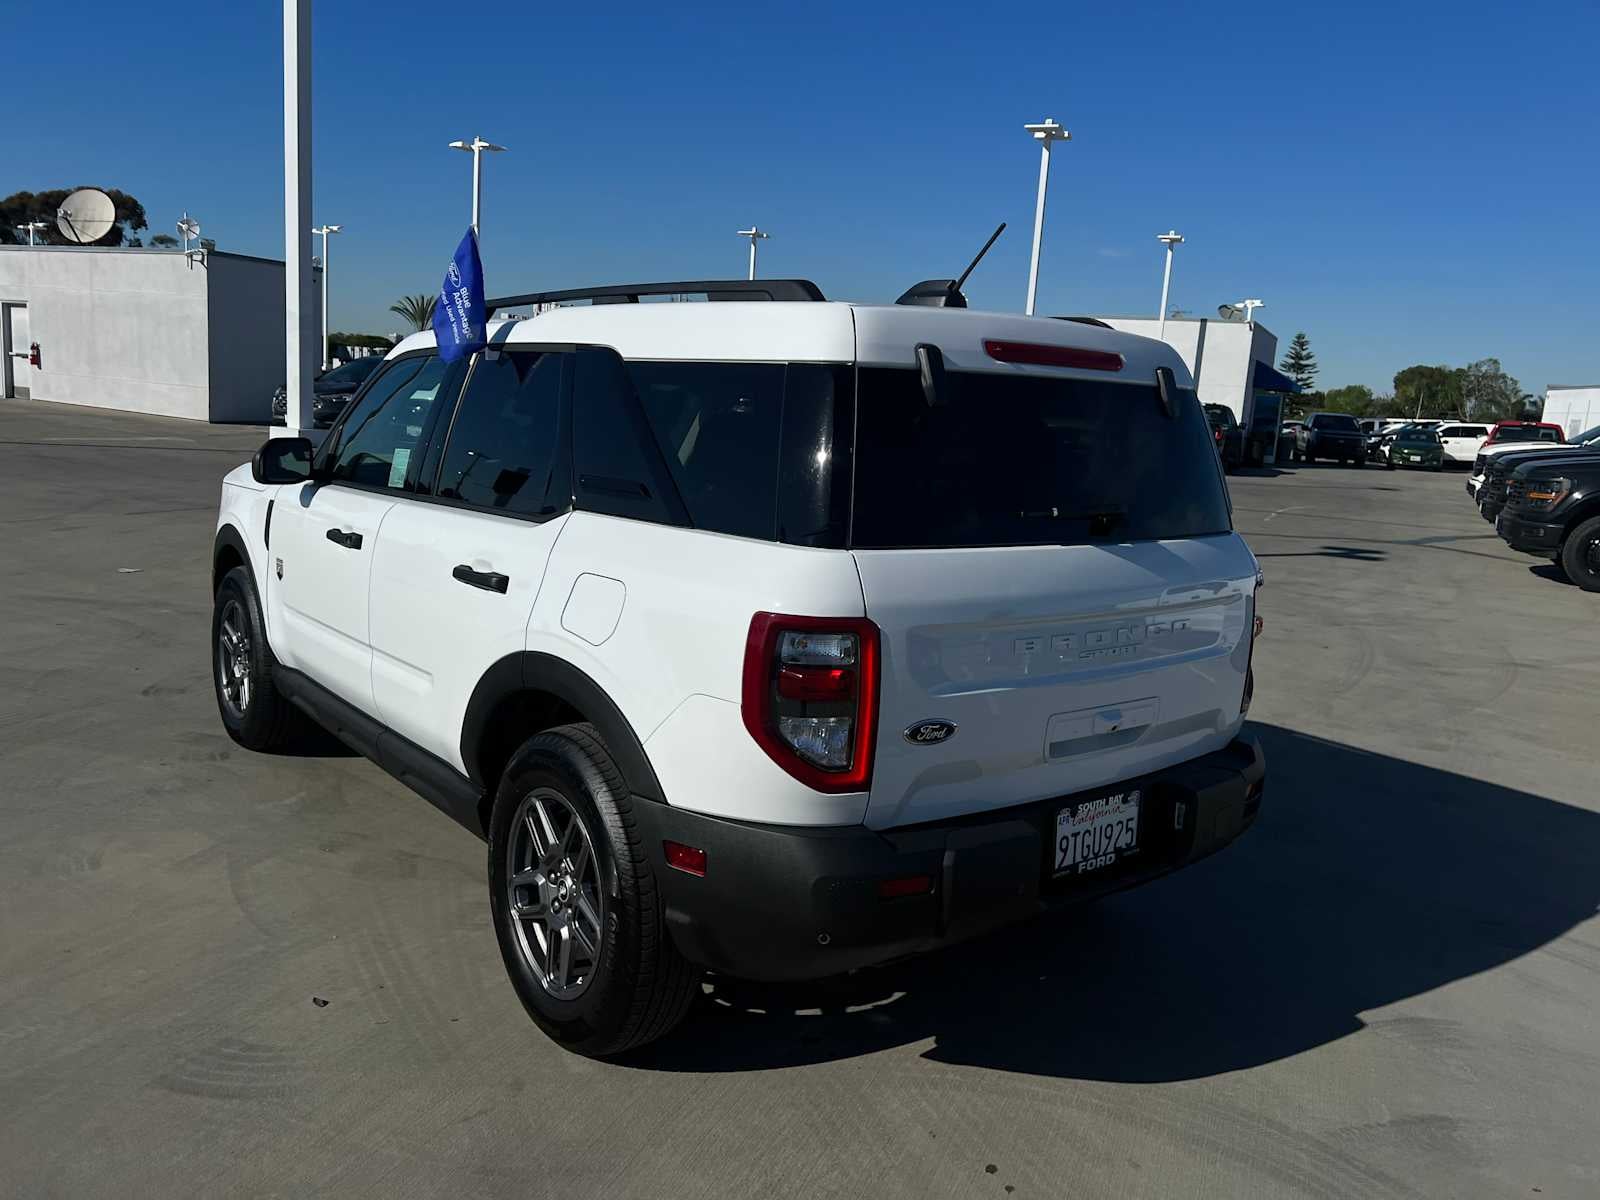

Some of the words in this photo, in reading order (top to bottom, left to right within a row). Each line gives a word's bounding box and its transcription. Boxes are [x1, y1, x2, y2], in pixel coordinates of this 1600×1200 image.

[460, 287, 471, 309] Blue
[446, 306, 455, 322] Used
[1014, 618, 1192, 656] BRONCO
[1079, 645, 1140, 661] SPORT
[1077, 798, 1106, 813] SOUTH
[1108, 793, 1124, 805] BAY
[1056, 818, 1135, 872] 9TGU925
[1077, 853, 1116, 874] FORD
